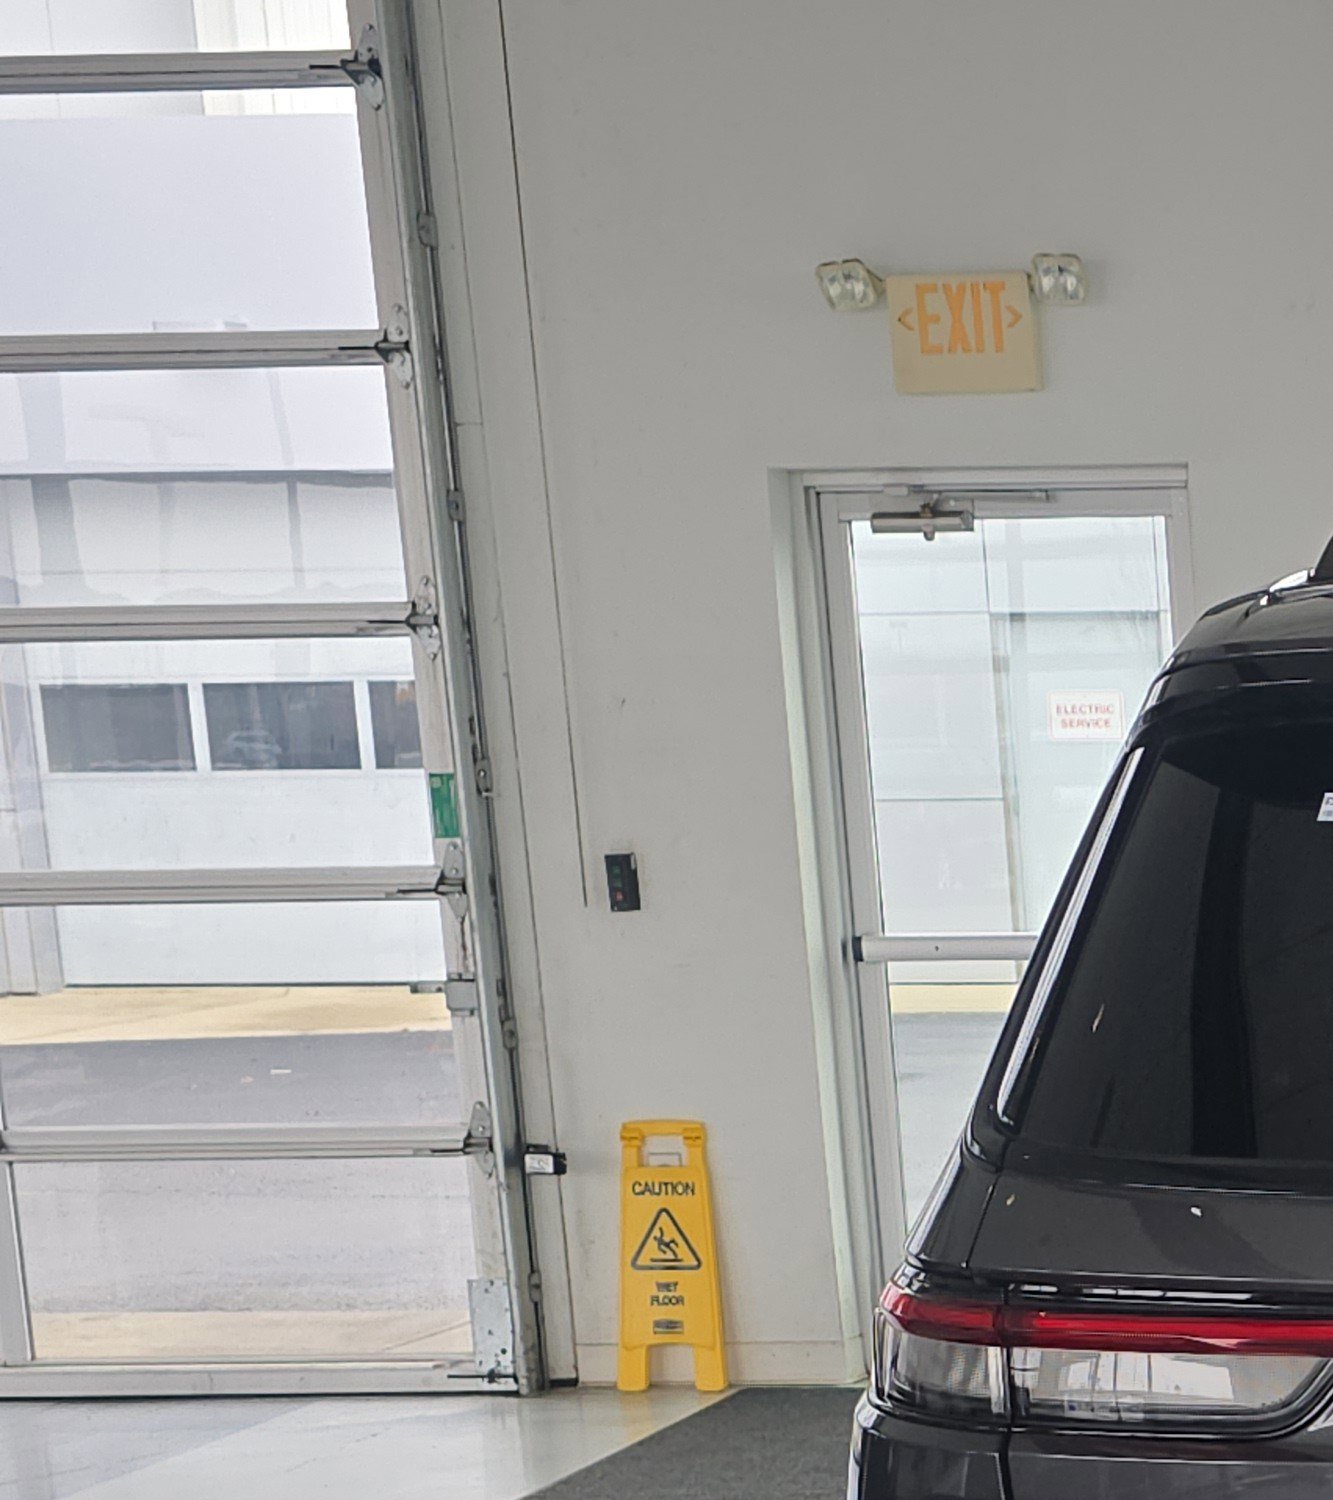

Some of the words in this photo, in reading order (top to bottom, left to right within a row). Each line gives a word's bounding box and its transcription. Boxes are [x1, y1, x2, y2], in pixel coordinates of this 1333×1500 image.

[915, 280, 1006, 355] EXIT
[1056, 703, 1115, 716] ELECTRIC
[1060, 718, 1112, 730] SERVICE
[631, 1181, 695, 1197] CAUTION
[655, 1281, 679, 1293] WET
[650, 1294, 685, 1307] FLOOR
